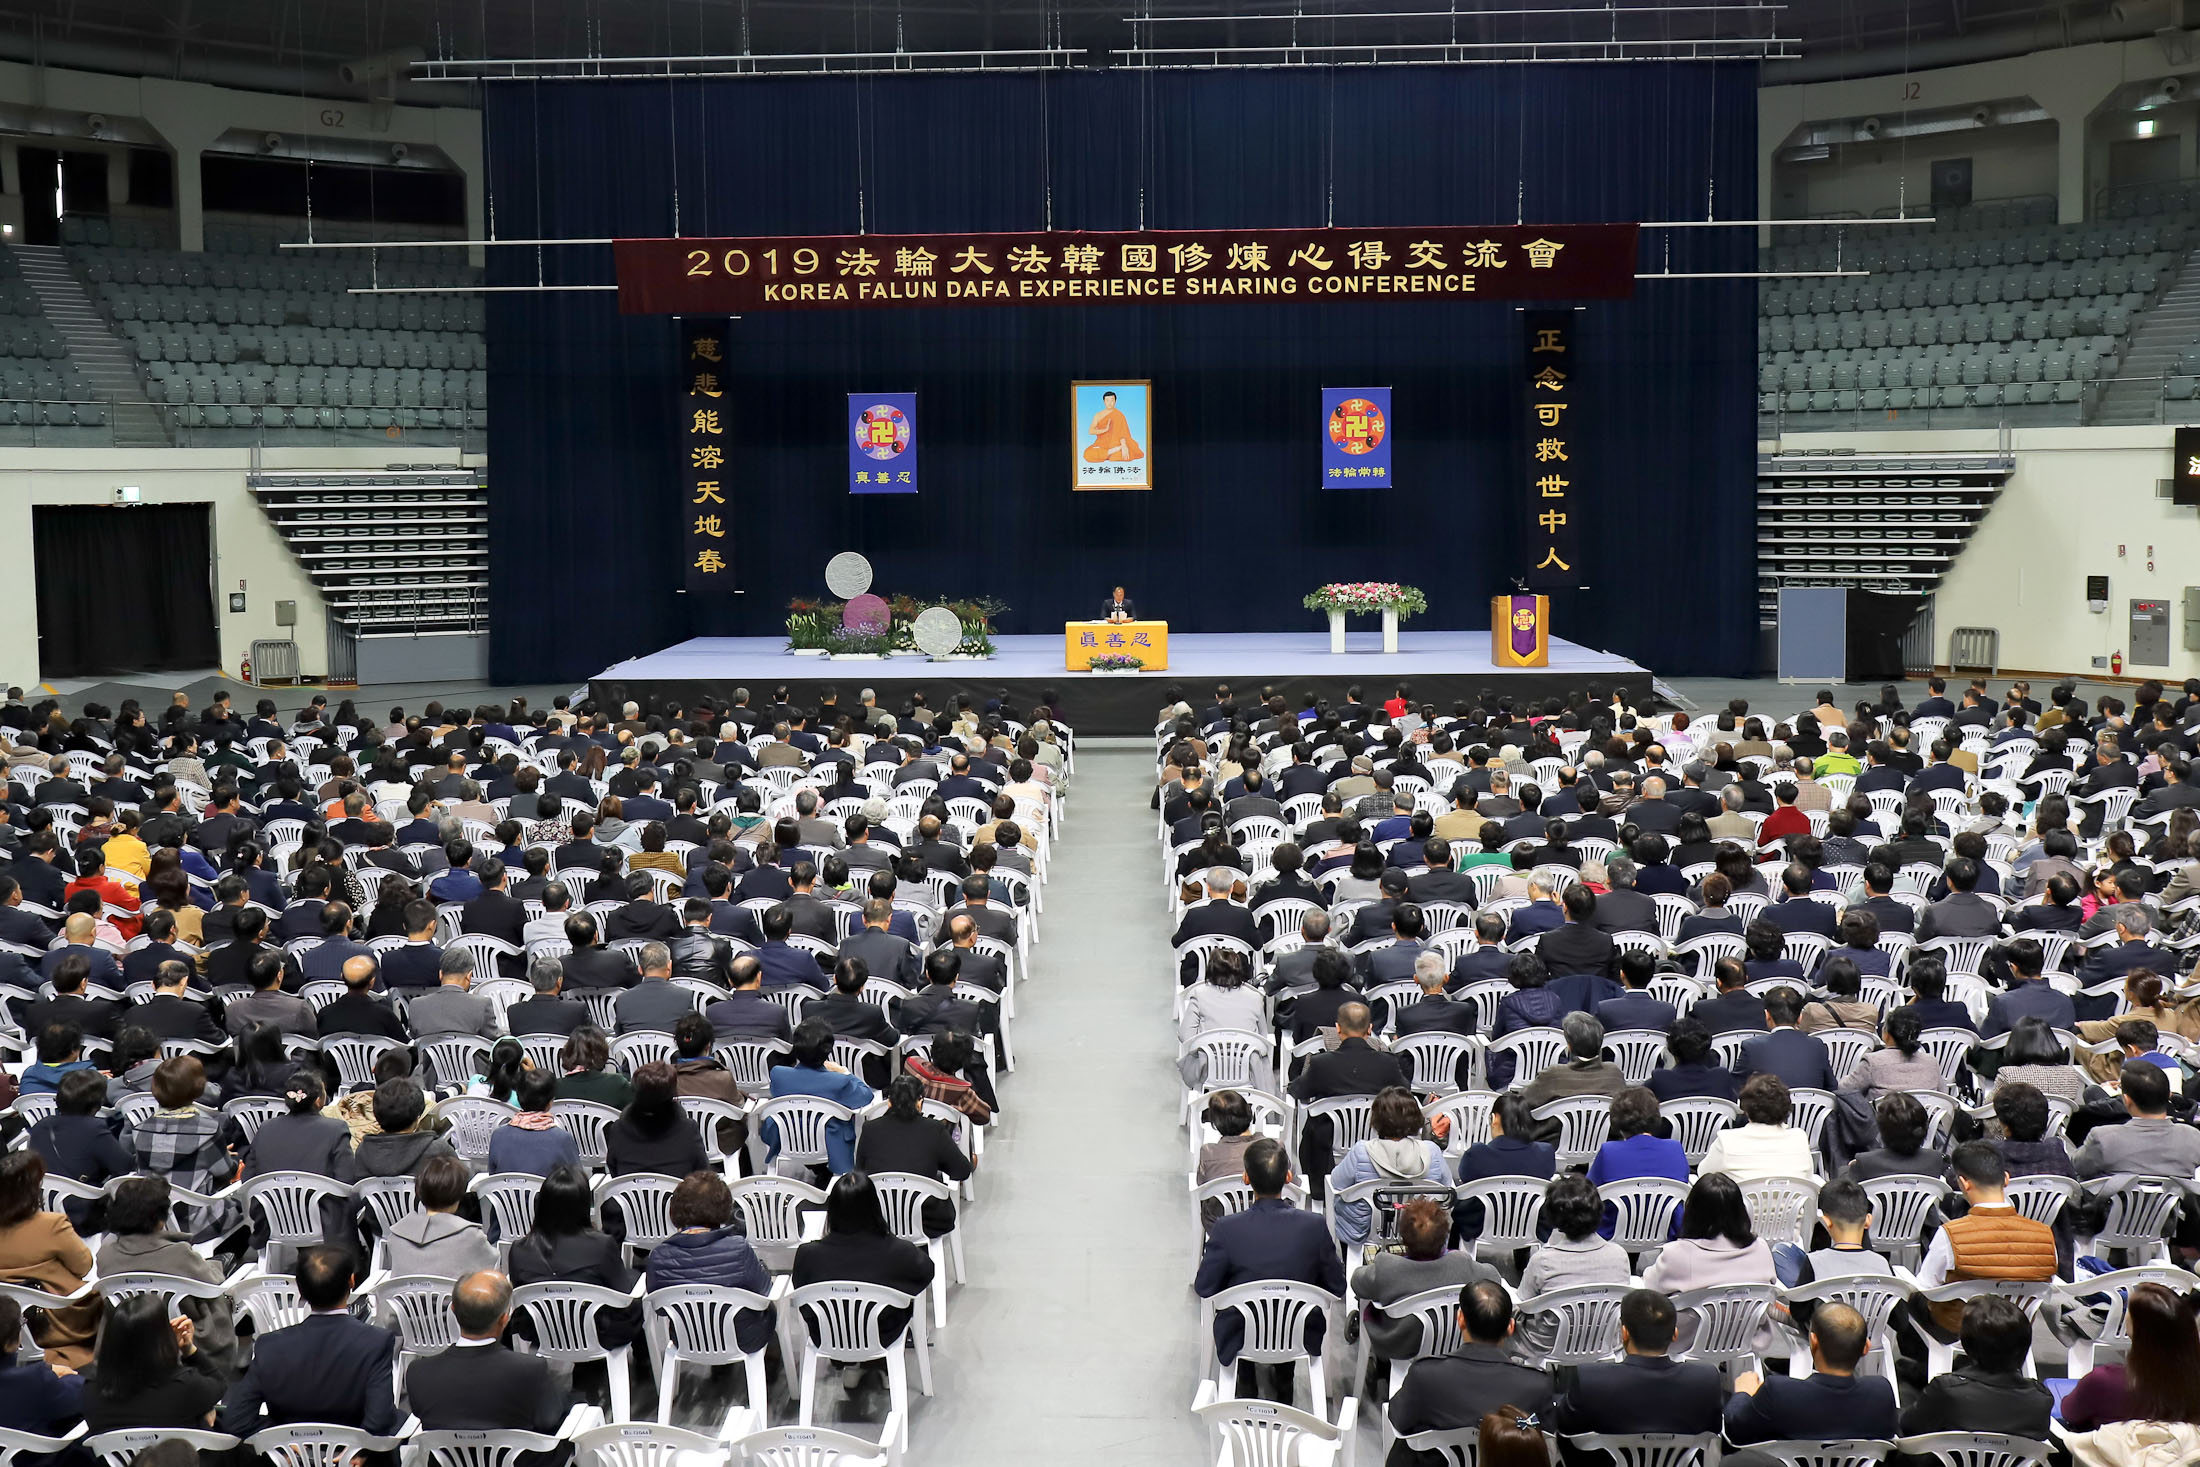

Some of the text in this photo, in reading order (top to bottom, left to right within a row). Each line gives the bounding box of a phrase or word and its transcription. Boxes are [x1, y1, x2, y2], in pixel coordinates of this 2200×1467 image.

[1901, 81, 1921, 101] J2
[320, 110, 345, 128] G2
[765, 274, 1476, 301] KOREA FALUN DAFA EXPERIENCE SHARING CONFERENCE
[1533, 330, 1570, 571] 正念可救世中人
